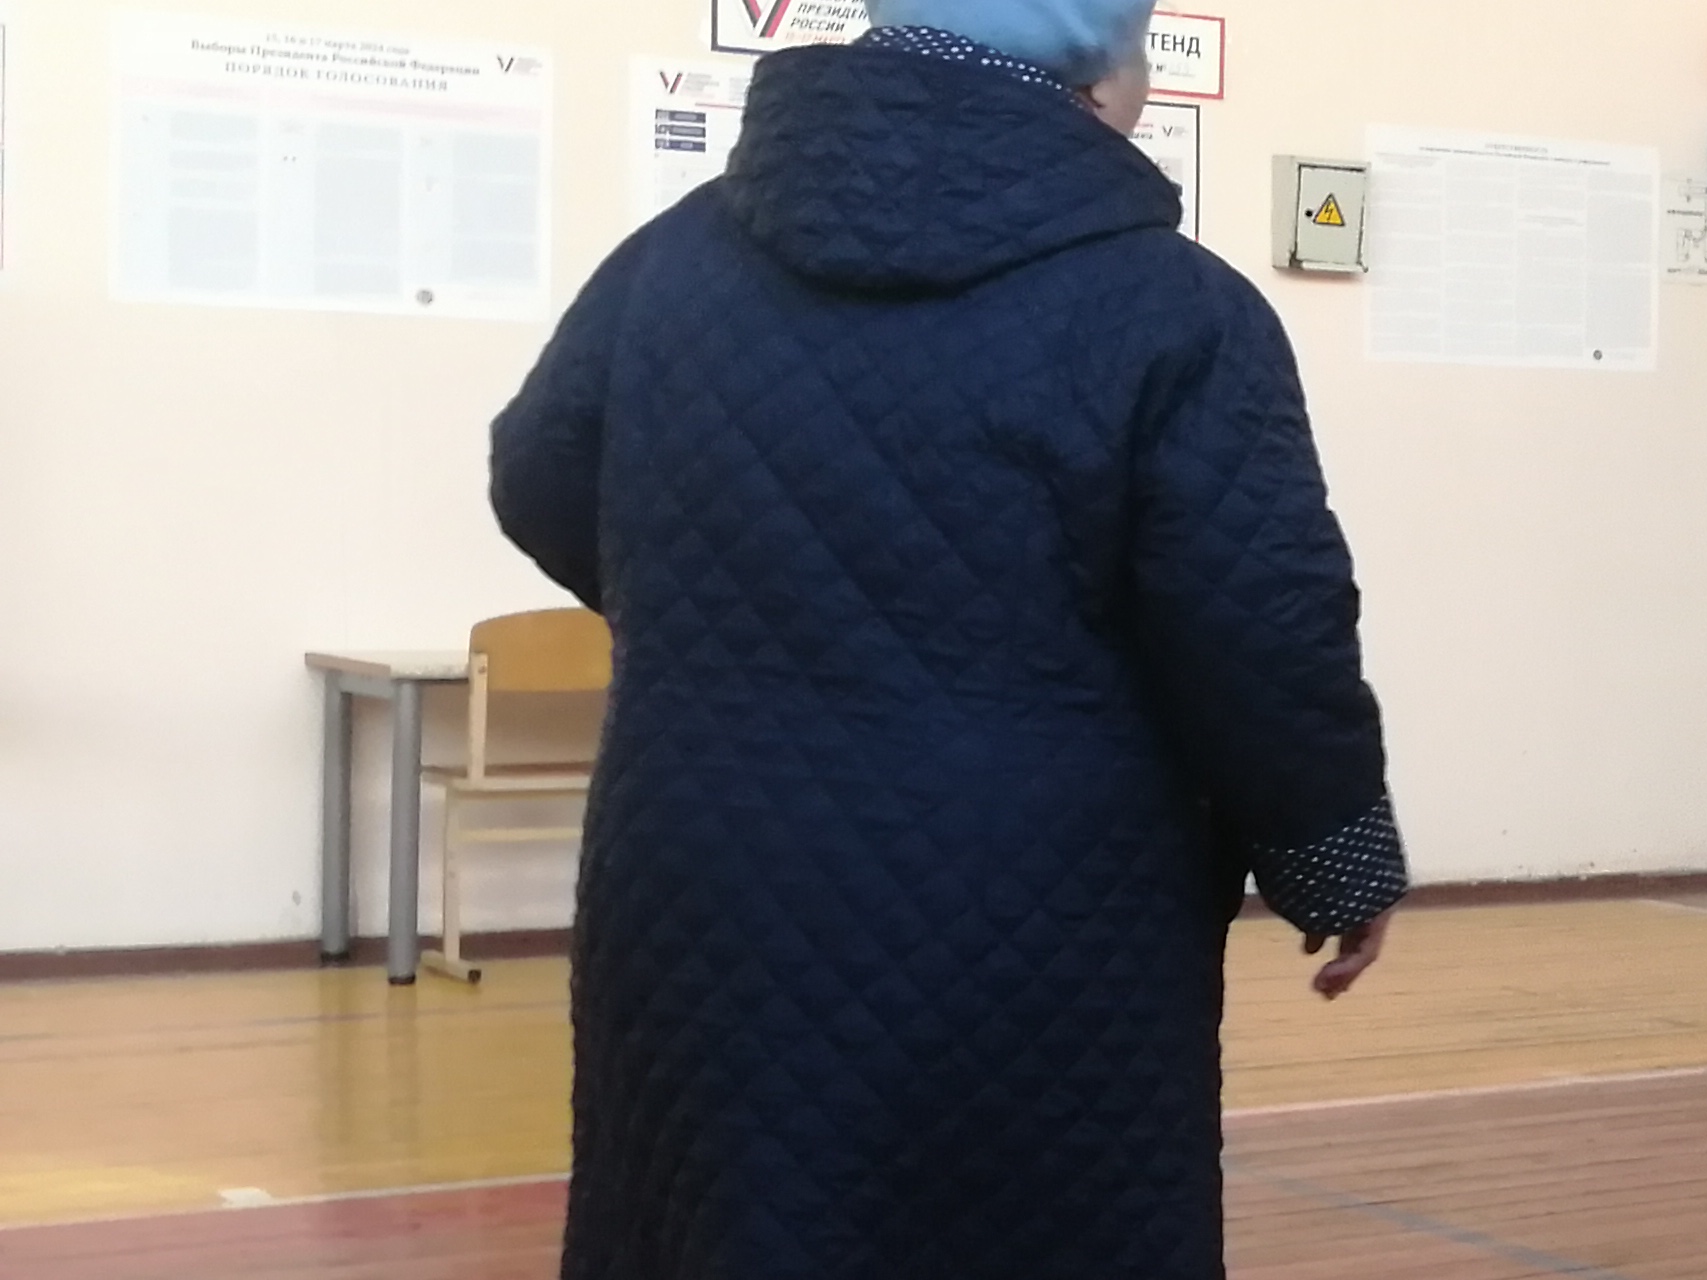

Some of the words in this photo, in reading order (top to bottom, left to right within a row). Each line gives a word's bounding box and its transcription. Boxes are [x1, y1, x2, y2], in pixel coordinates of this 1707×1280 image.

[797, 3, 868, 21] ПРЕЗИДЕН
[790, 18, 845, 33] РОССИИ
[1147, 32, 1201, 59] ТЕНД
[225, 61, 310, 80] ПОРЯДОК
[315, 69, 449, 92] ГОЛОСОВАНИЯ
